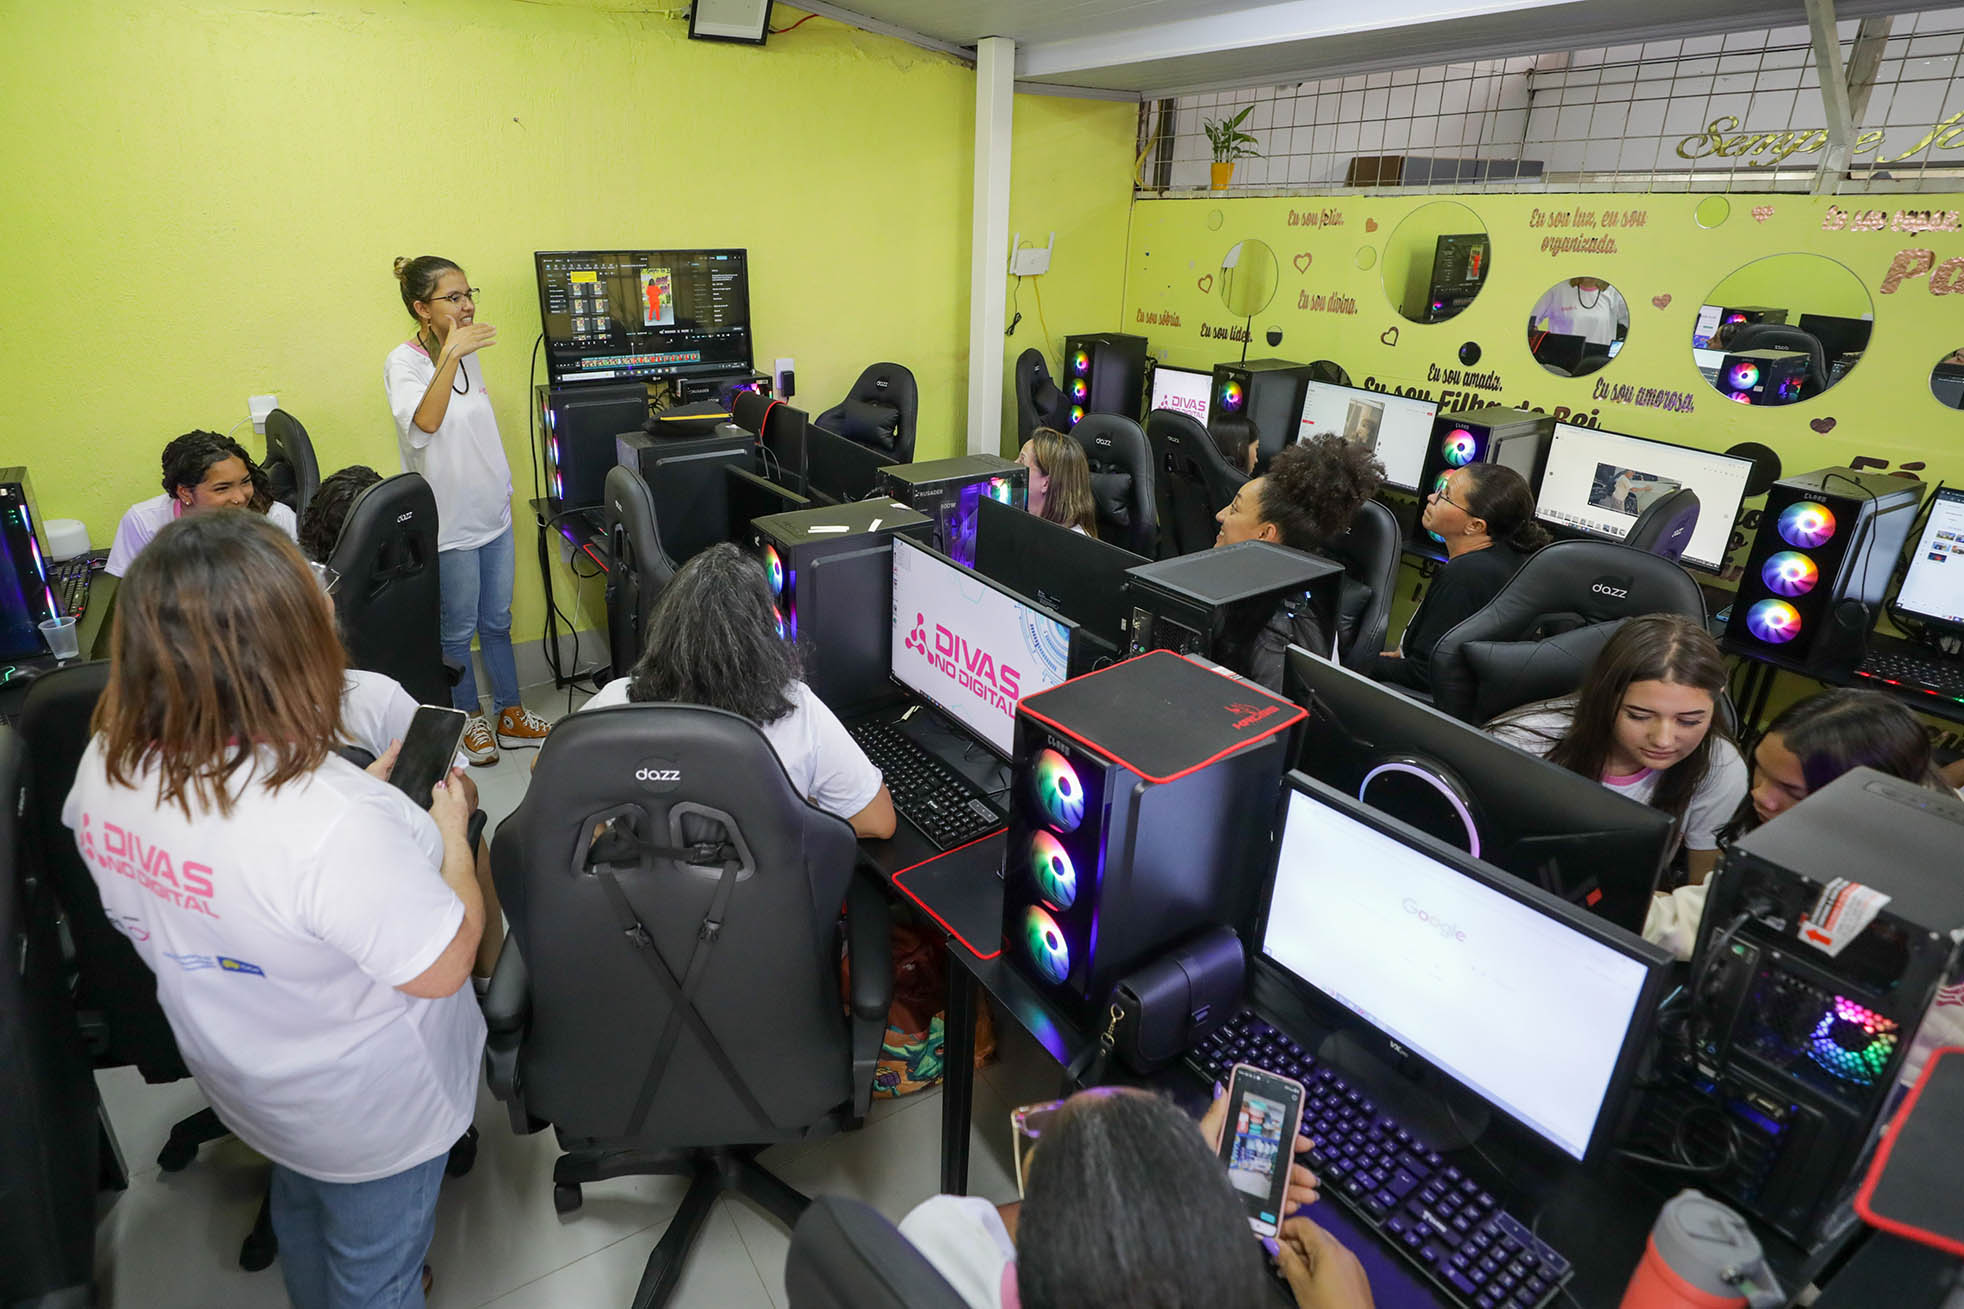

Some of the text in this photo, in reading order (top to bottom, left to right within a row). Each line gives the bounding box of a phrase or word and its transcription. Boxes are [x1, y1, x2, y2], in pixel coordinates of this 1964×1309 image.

[1676, 115, 1884, 167] Sempe
[1288, 209, 1299, 226] Eu
[1301, 212, 1318, 226] sou
[1529, 208, 1544, 228] Eu
[1549, 212, 1570, 228] sou
[1601, 209, 1619, 228] eu
[1621, 210, 1648, 228] sou
[1298, 290, 1308, 310] Eu
[1310, 296, 1326, 312] sou
[1136, 308, 1145, 323] Eu
[1146, 312, 1157, 325] sou
[1200, 322, 1211, 337] Eu
[1213, 326, 1228, 339] sou
[1428, 363, 1503, 392] Eu sou amada.
[1592, 377, 1609, 400] Eu
[1610, 384, 1633, 404] sou
[1172, 395, 1206, 412] DIVAS
[1592, 584, 1628, 599] dazz
[935, 623, 1021, 701] DIVAS
[934, 655, 1017, 720] NO DIGITAL
[635, 767, 681, 781] dazz
[103, 821, 214, 899] DIVAS
[136, 868, 221, 920] DIGITAL
[1402, 897, 1466, 943] Google
